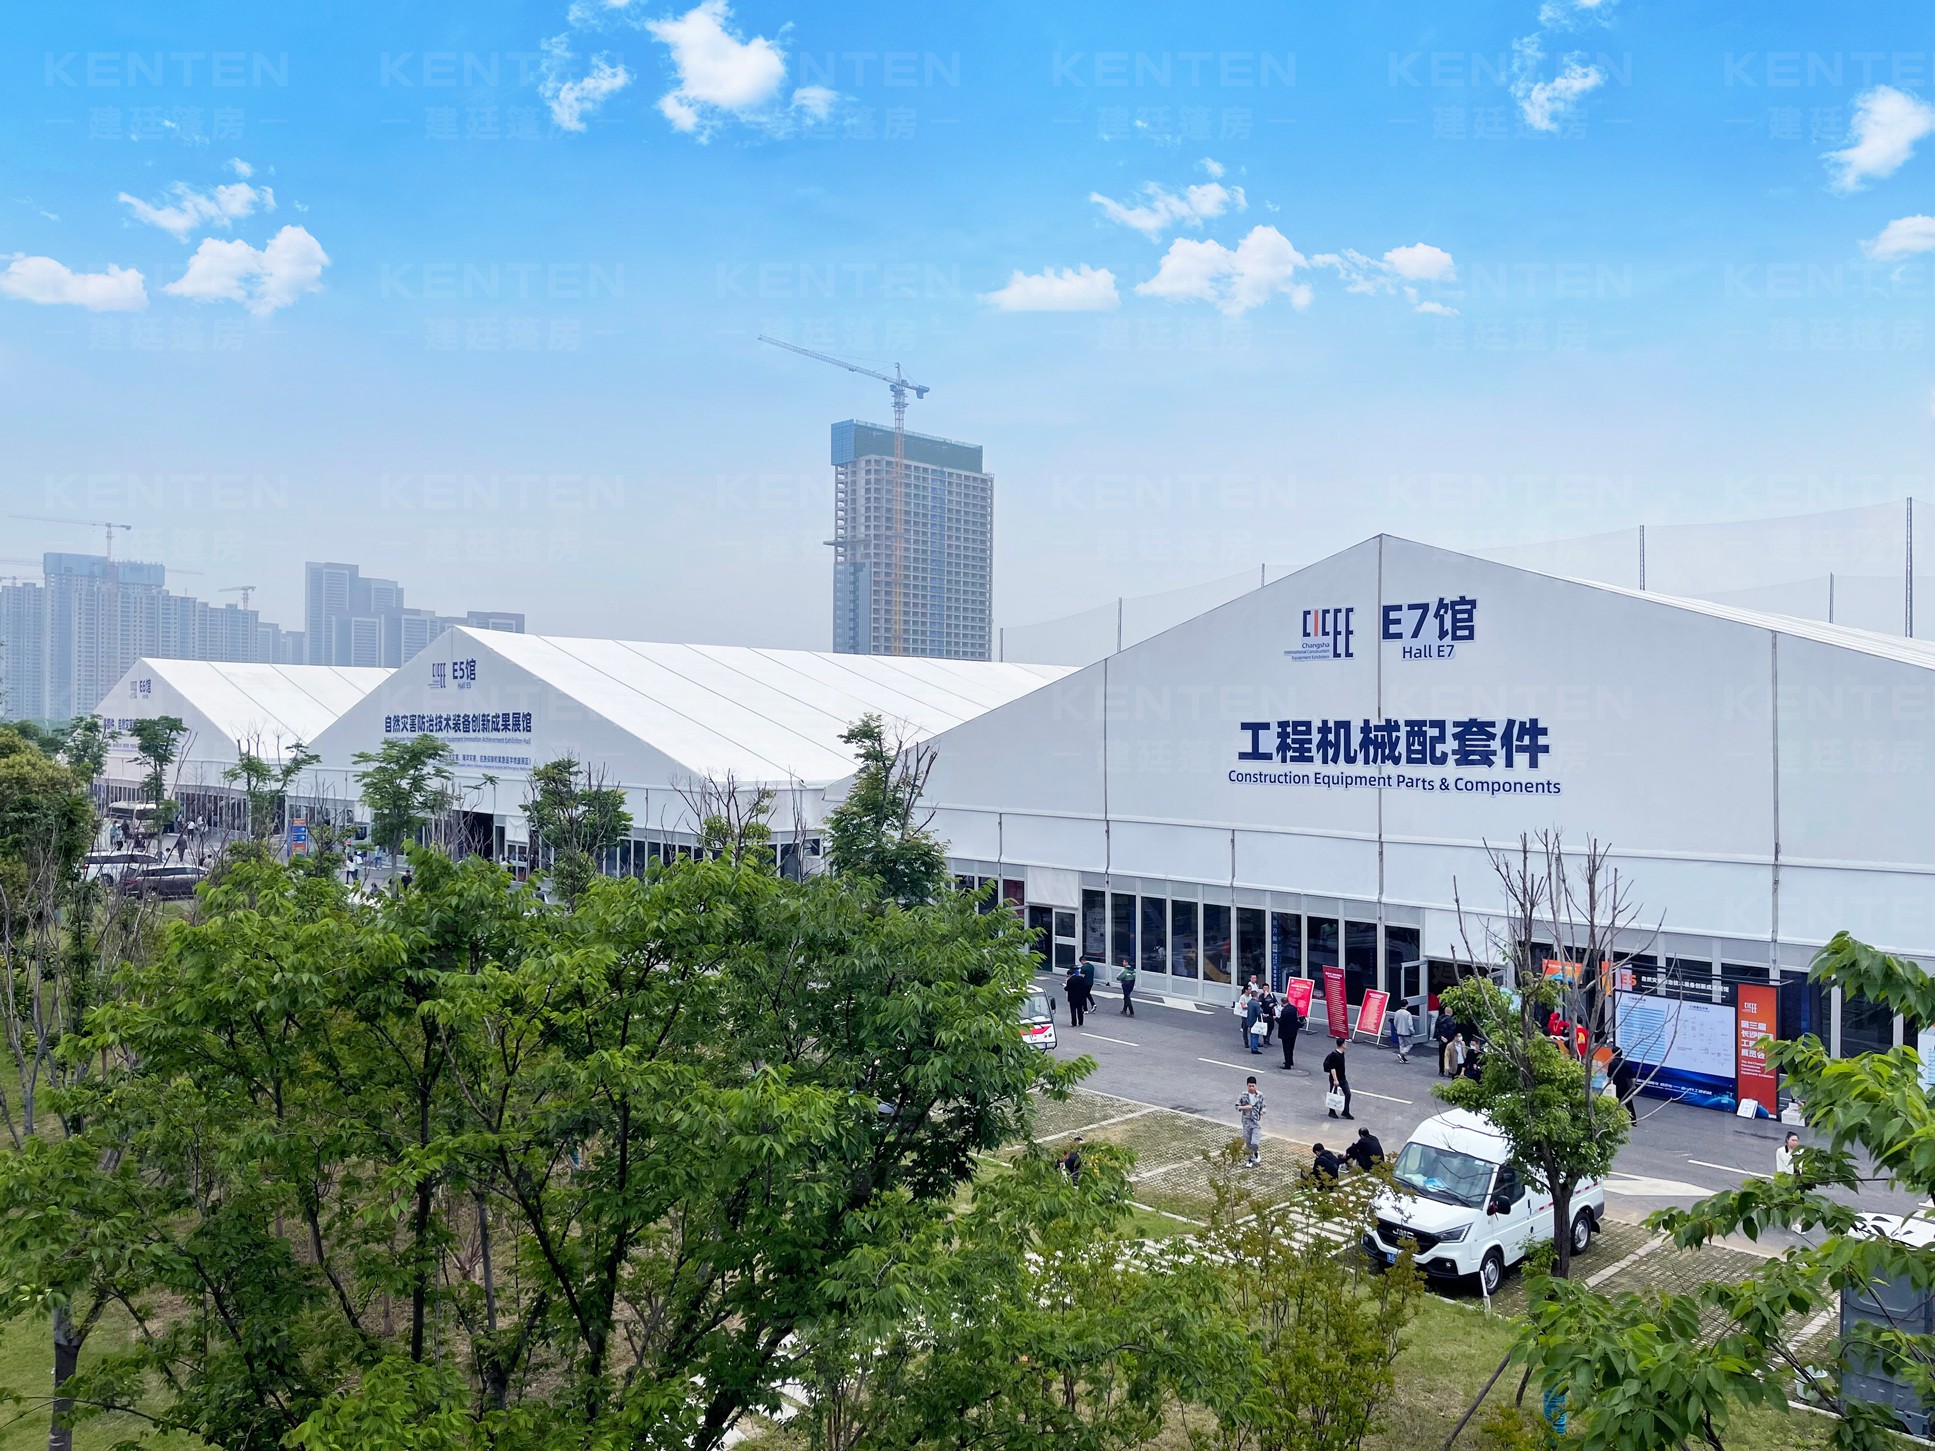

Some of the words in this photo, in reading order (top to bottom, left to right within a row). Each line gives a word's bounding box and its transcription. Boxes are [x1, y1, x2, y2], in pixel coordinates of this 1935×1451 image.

[1382, 596, 1477, 641] E7馆
[1402, 646, 1432, 658] Hall
[1438, 645, 1454, 657] E7
[453, 659, 476, 680] E5馆
[385, 712, 532, 733] 自然灾害防治技术装备创新成果展馆
[1238, 718, 1550, 768] 工程机械配套件
[1228, 769, 1310, 785] Construction
[1314, 772, 1393, 788] Equipment
[1397, 774, 1435, 791] Parts
[1439, 777, 1450, 791] &
[1454, 777, 1561, 796] Components
